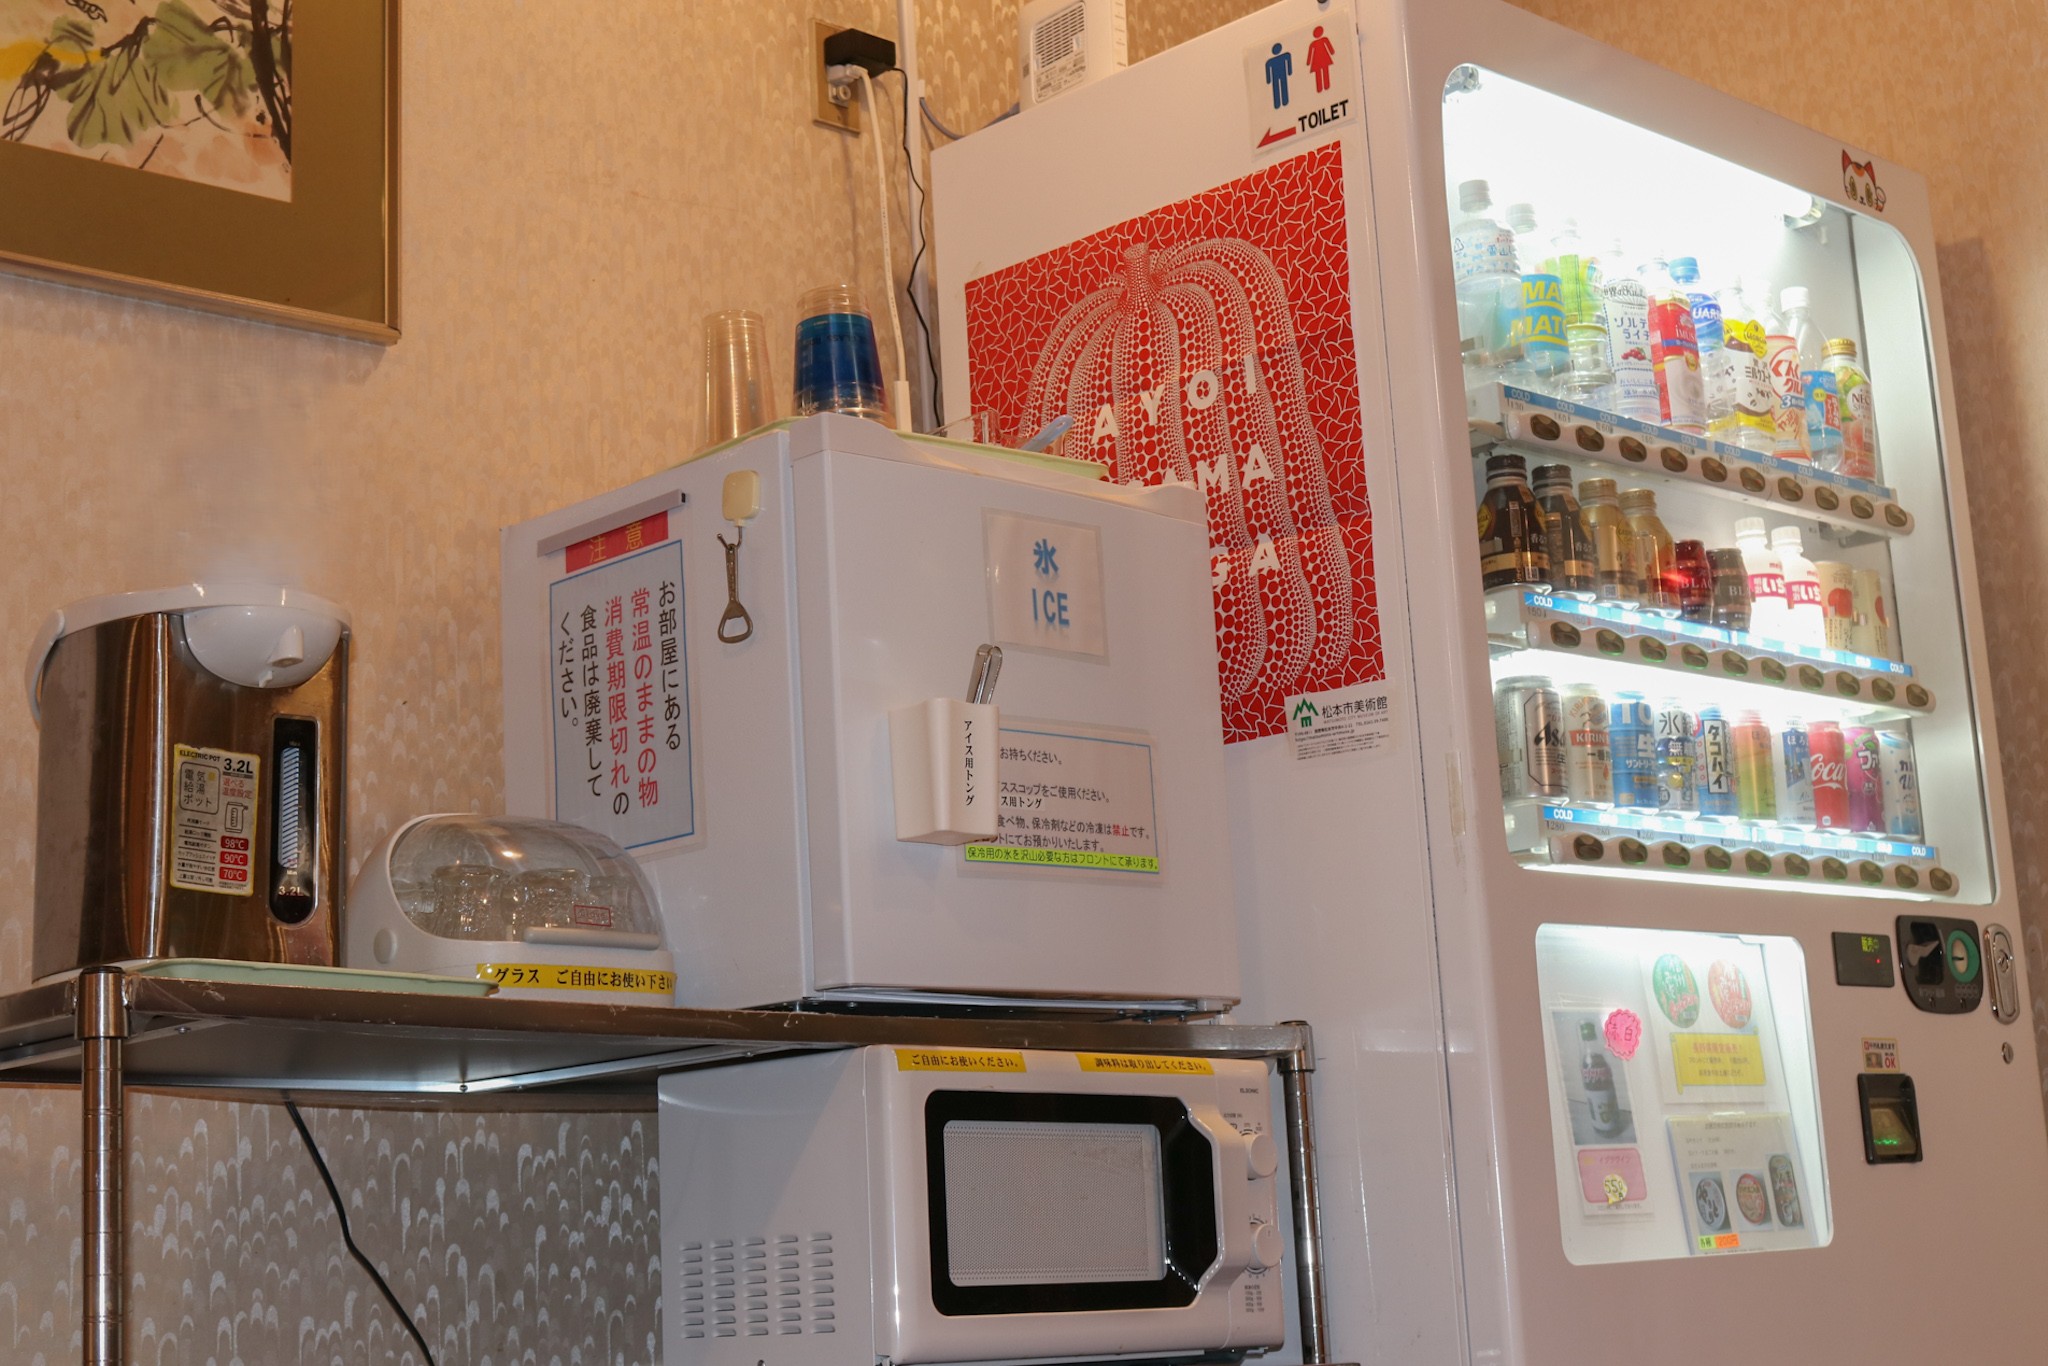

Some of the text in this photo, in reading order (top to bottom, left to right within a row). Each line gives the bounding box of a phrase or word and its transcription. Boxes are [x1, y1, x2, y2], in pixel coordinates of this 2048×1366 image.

[1298, 99, 1349, 132] TOILET
[1556, 401, 1575, 413] COLD
[1600, 413, 1618, 425] COLD
[1641, 423, 1659, 436] COLD
[1033, 538, 1059, 576] 氷
[1031, 587, 1070, 627] ICE
[1533, 595, 1553, 607] COLD
[558, 611, 579, 727] ください。
[659, 580, 681, 750] お部屋にある
[580, 604, 602, 797] 食品は廃棄して
[604, 596, 630, 815] 消費期限切れの
[630, 587, 659, 808] 常温のままの物
[1322, 695, 1388, 719] 松本市美術館
[179, 749, 208, 760] ELECTRIC
[964, 720, 975, 806] アイス用トング
[224, 757, 253, 774] 3.2L
[1000, 796, 1042, 810] ス用トング
[1553, 808, 1573, 820] COLD
[494, 967, 673, 990] グラス ご自由にお使い下さい
[911, 1054, 1019, 1068] ご自由にお使いください。
[1095, 1057, 1207, 1071] 調味料は取り出してください。
[1884, 1056, 1896, 1068] OK
